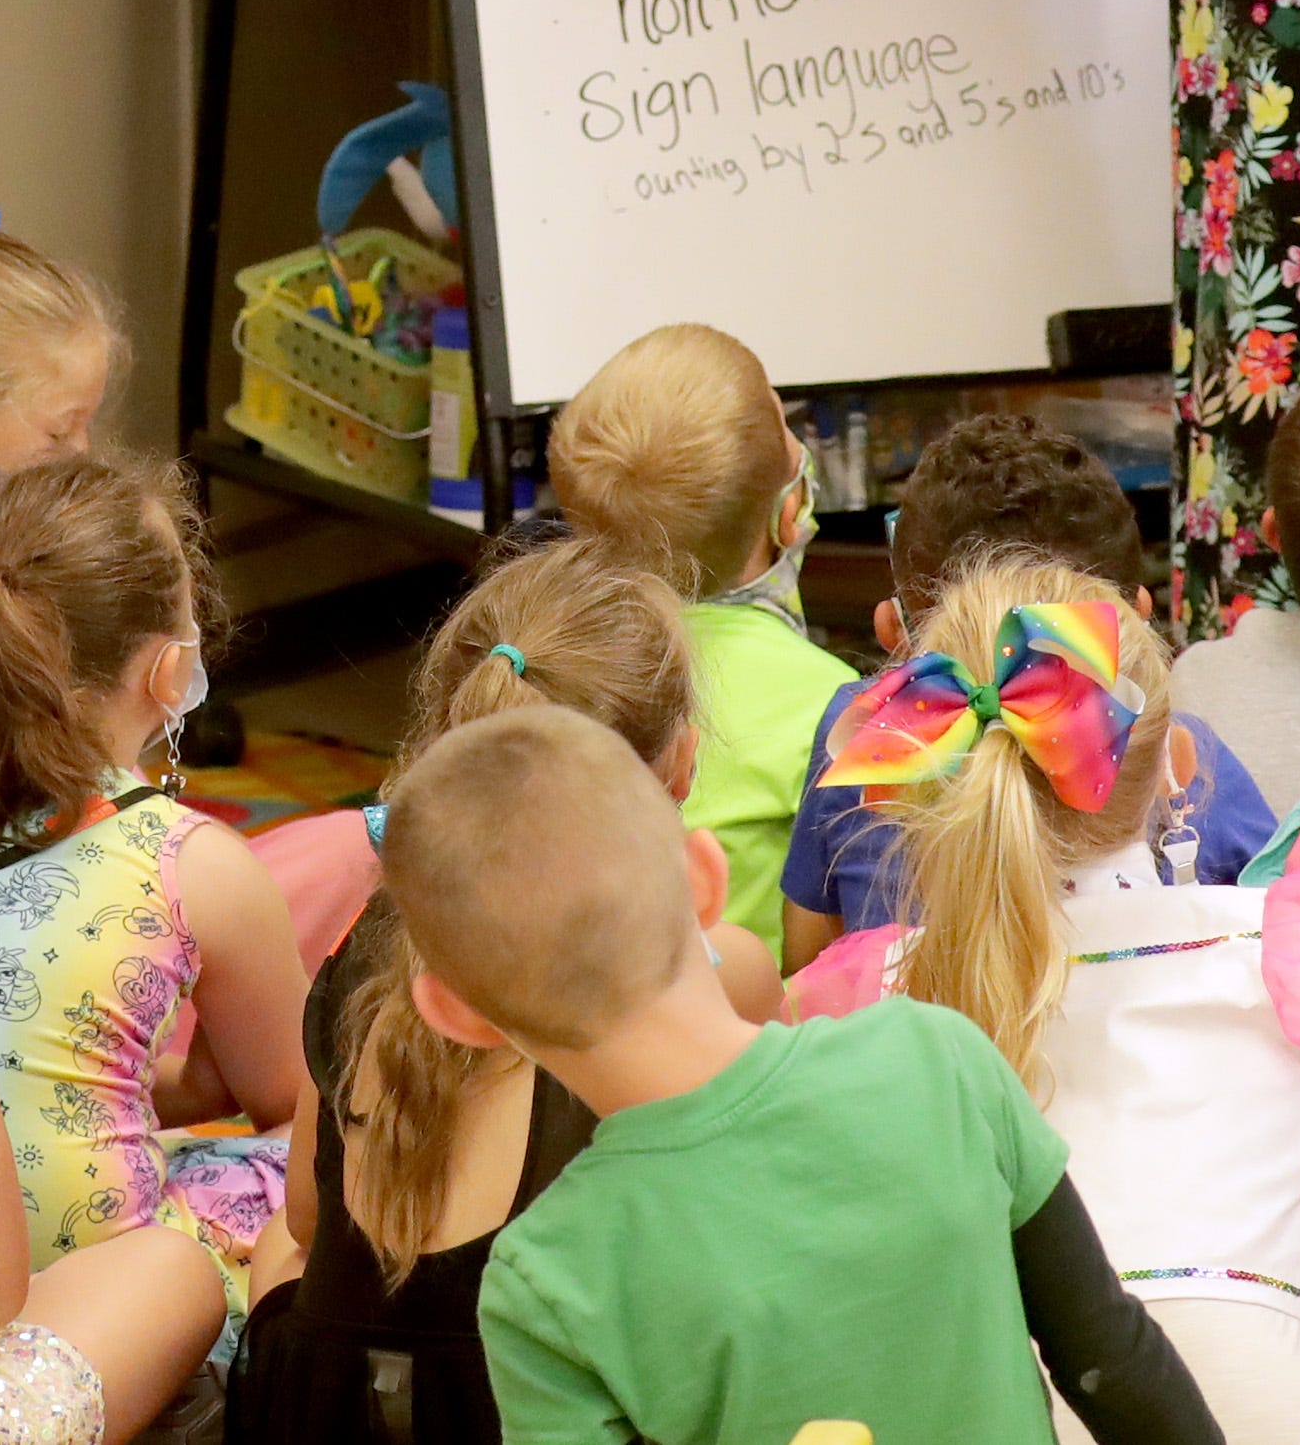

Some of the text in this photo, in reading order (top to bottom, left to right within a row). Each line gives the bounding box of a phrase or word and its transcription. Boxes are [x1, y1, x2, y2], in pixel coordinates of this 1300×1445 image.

[578, 33, 969, 152] Sign language
[752, 133, 813, 193] by
[900, 103, 953, 148] and
[1024, 69, 1069, 109] and
